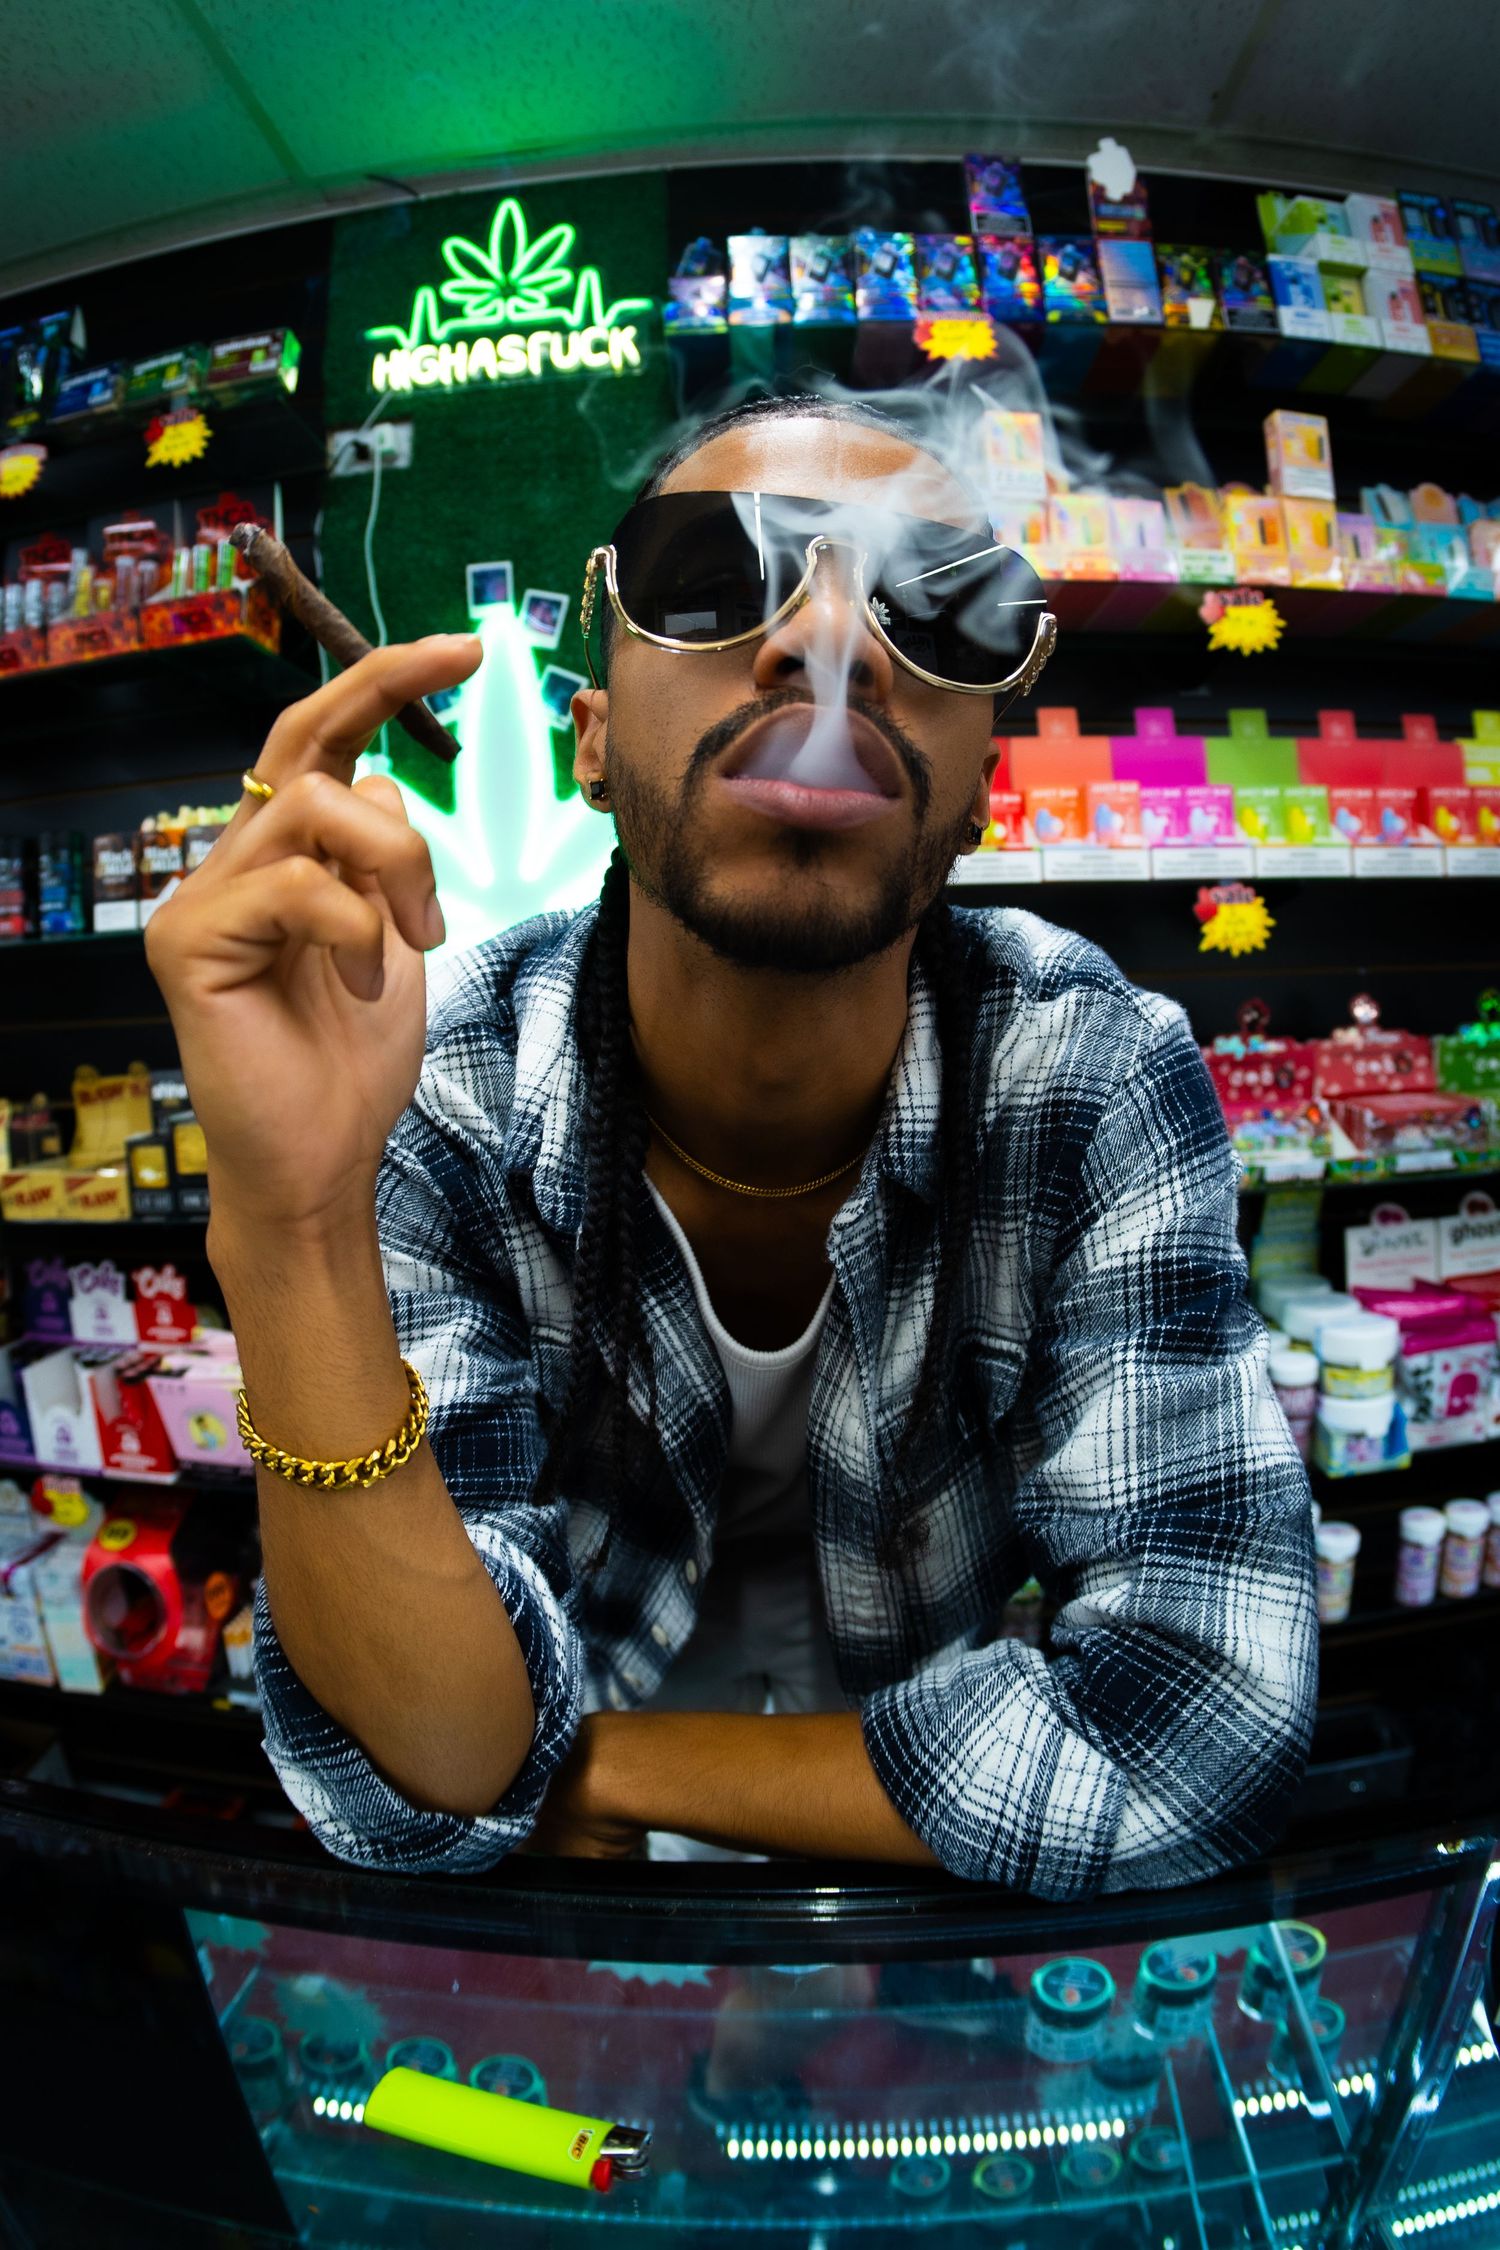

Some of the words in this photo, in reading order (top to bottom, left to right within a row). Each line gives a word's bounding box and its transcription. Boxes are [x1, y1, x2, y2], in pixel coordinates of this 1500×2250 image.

[372, 326, 642, 394] HIGHASFUCK
[78, 1082, 124, 1106] RAW
[15, 1186, 52, 1207] RAW
[80, 1189, 119, 1208] RAW
